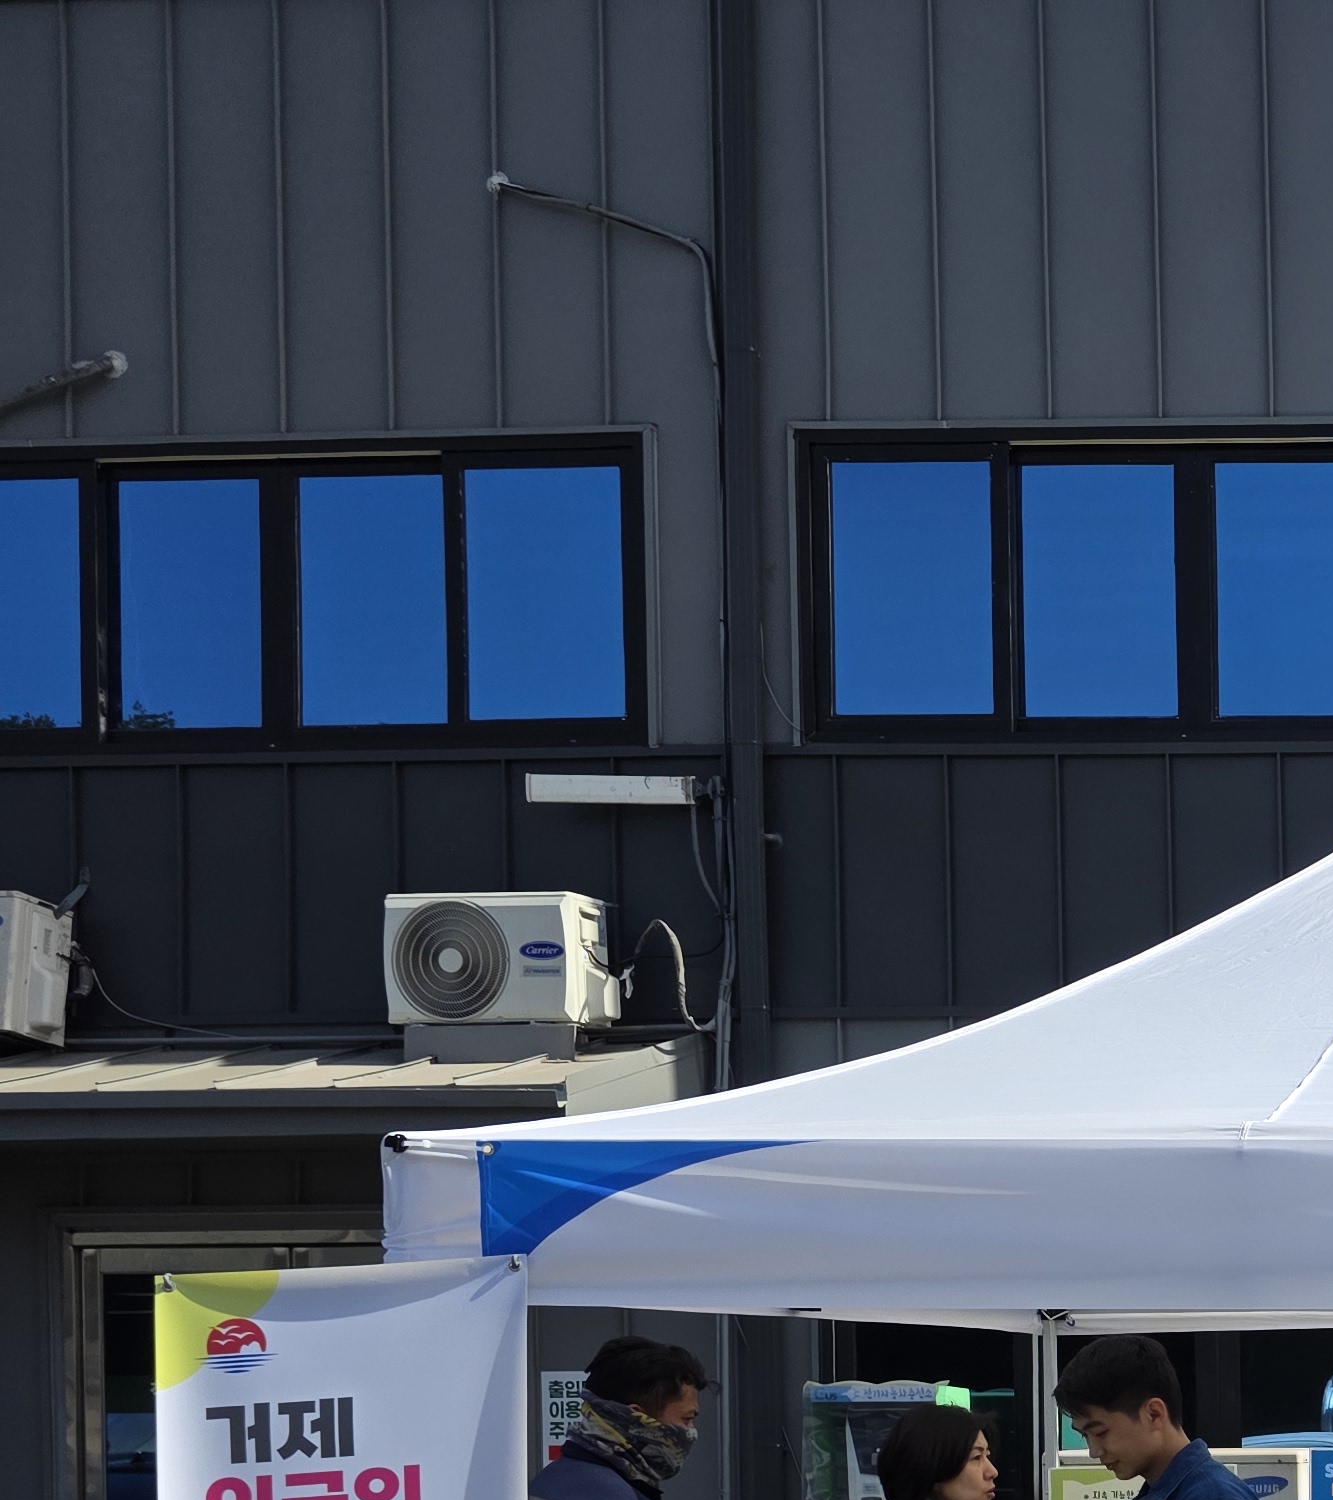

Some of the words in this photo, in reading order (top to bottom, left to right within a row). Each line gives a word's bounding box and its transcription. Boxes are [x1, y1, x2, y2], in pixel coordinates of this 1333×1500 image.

[526, 945, 559, 955] Carrier
[549, 1400, 581, 1419] 이용
[205, 1396, 354, 1465] 거제
